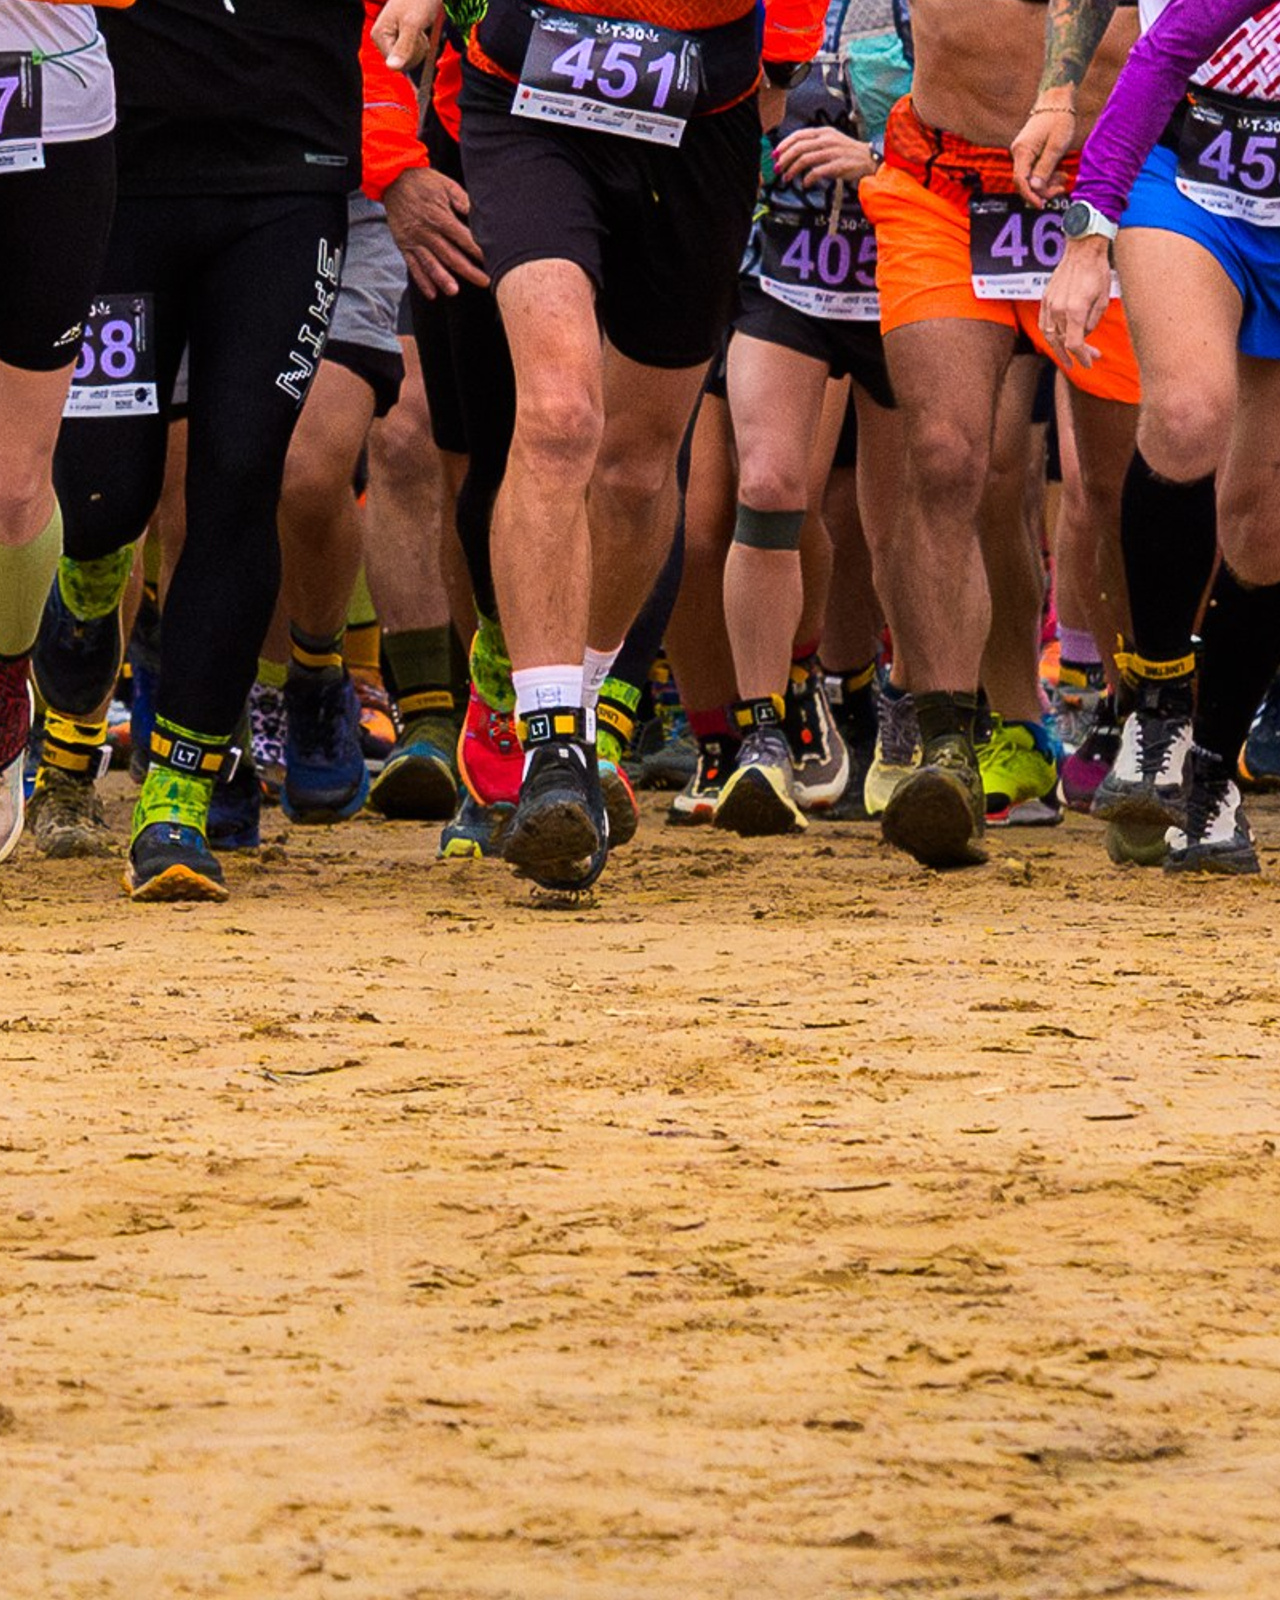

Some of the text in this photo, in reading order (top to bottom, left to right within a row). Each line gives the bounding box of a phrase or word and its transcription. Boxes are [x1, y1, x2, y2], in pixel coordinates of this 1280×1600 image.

[551, 37, 677, 109] 451
[1198, 129, 1280, 191] 45
[990, 212, 1066, 268] 46
[275, 237, 342, 400] NIKE
[177, 749, 195, 763] LT
[531, 721, 545, 736] LT
